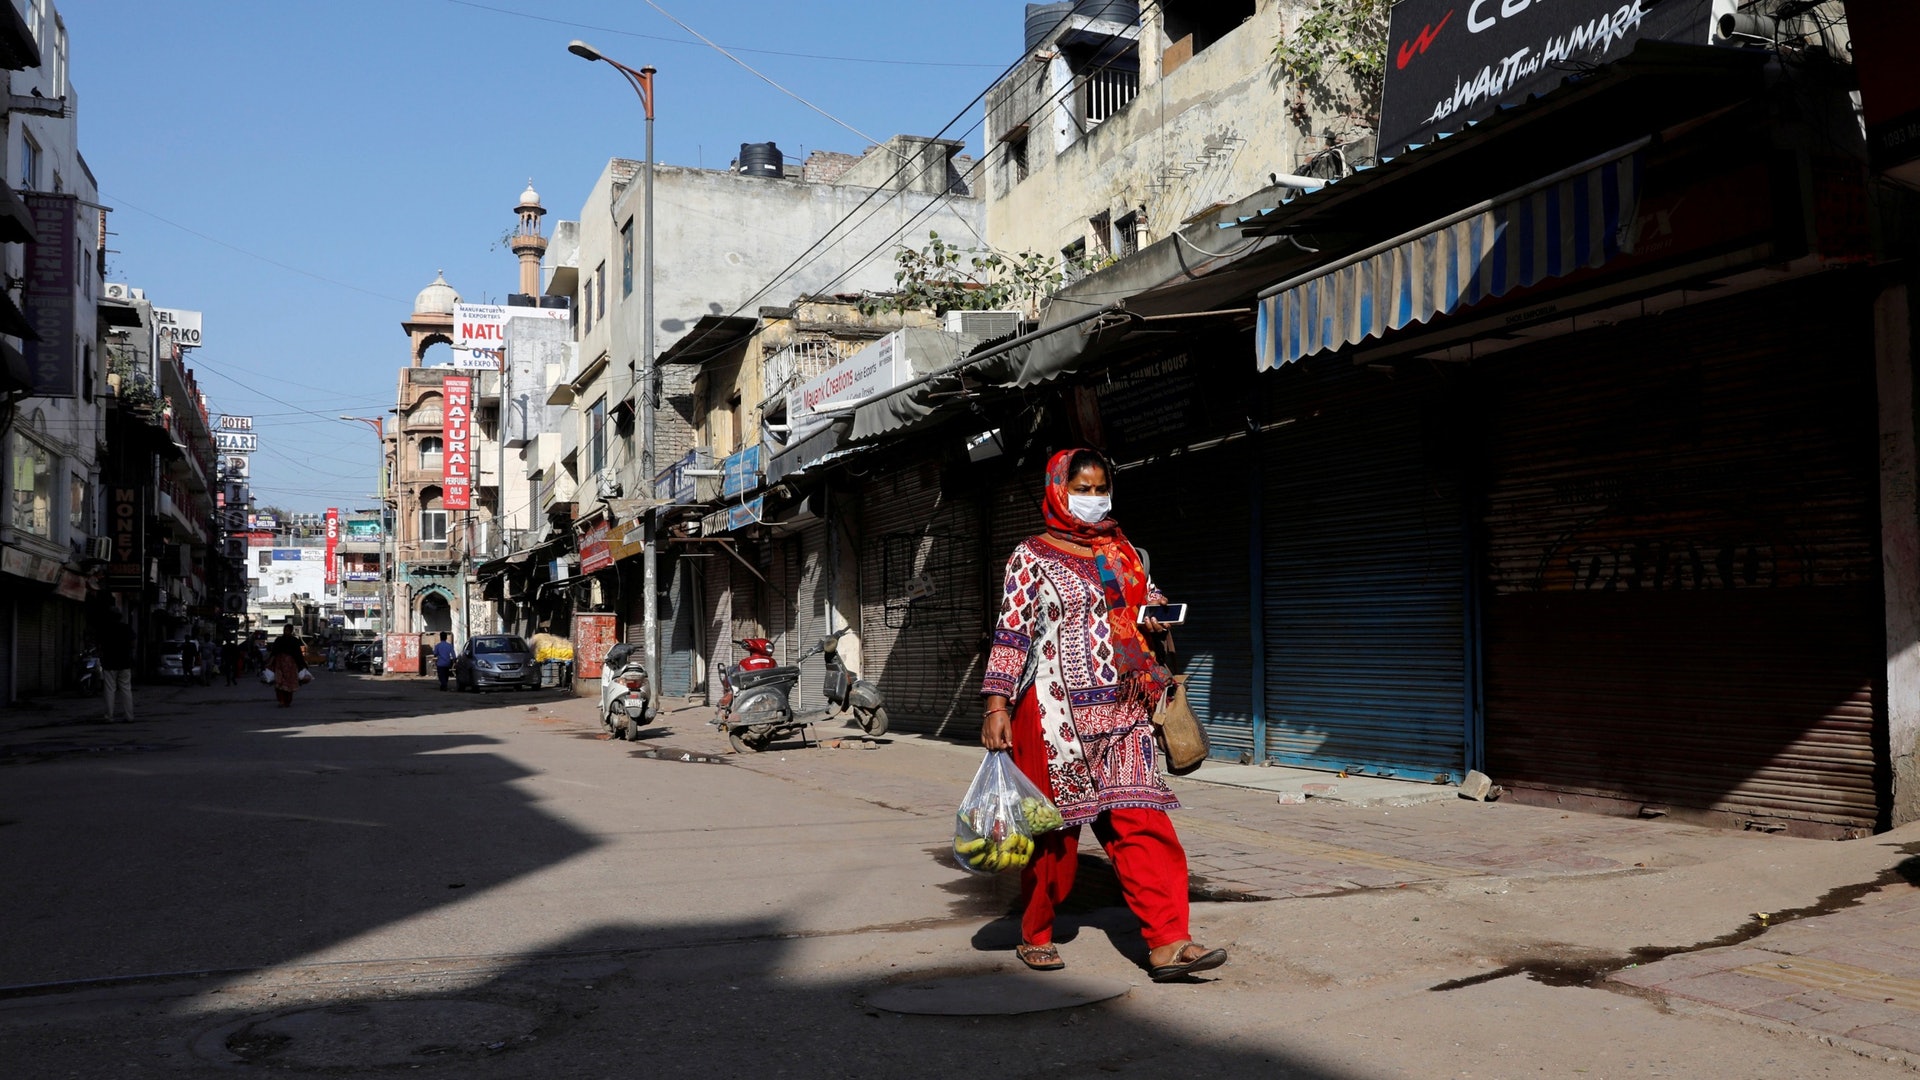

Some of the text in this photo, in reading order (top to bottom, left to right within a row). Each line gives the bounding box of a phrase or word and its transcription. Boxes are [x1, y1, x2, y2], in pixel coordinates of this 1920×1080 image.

[825, 369, 853, 398] Creations
[221, 416, 251, 430] HOTEL
[217, 434, 256, 449] HARI
[448, 395, 466, 476] NATURAL
[445, 477, 468, 486] PERFUME
[115, 488, 135, 562] MONEY
[328, 518, 337, 538] OYO
